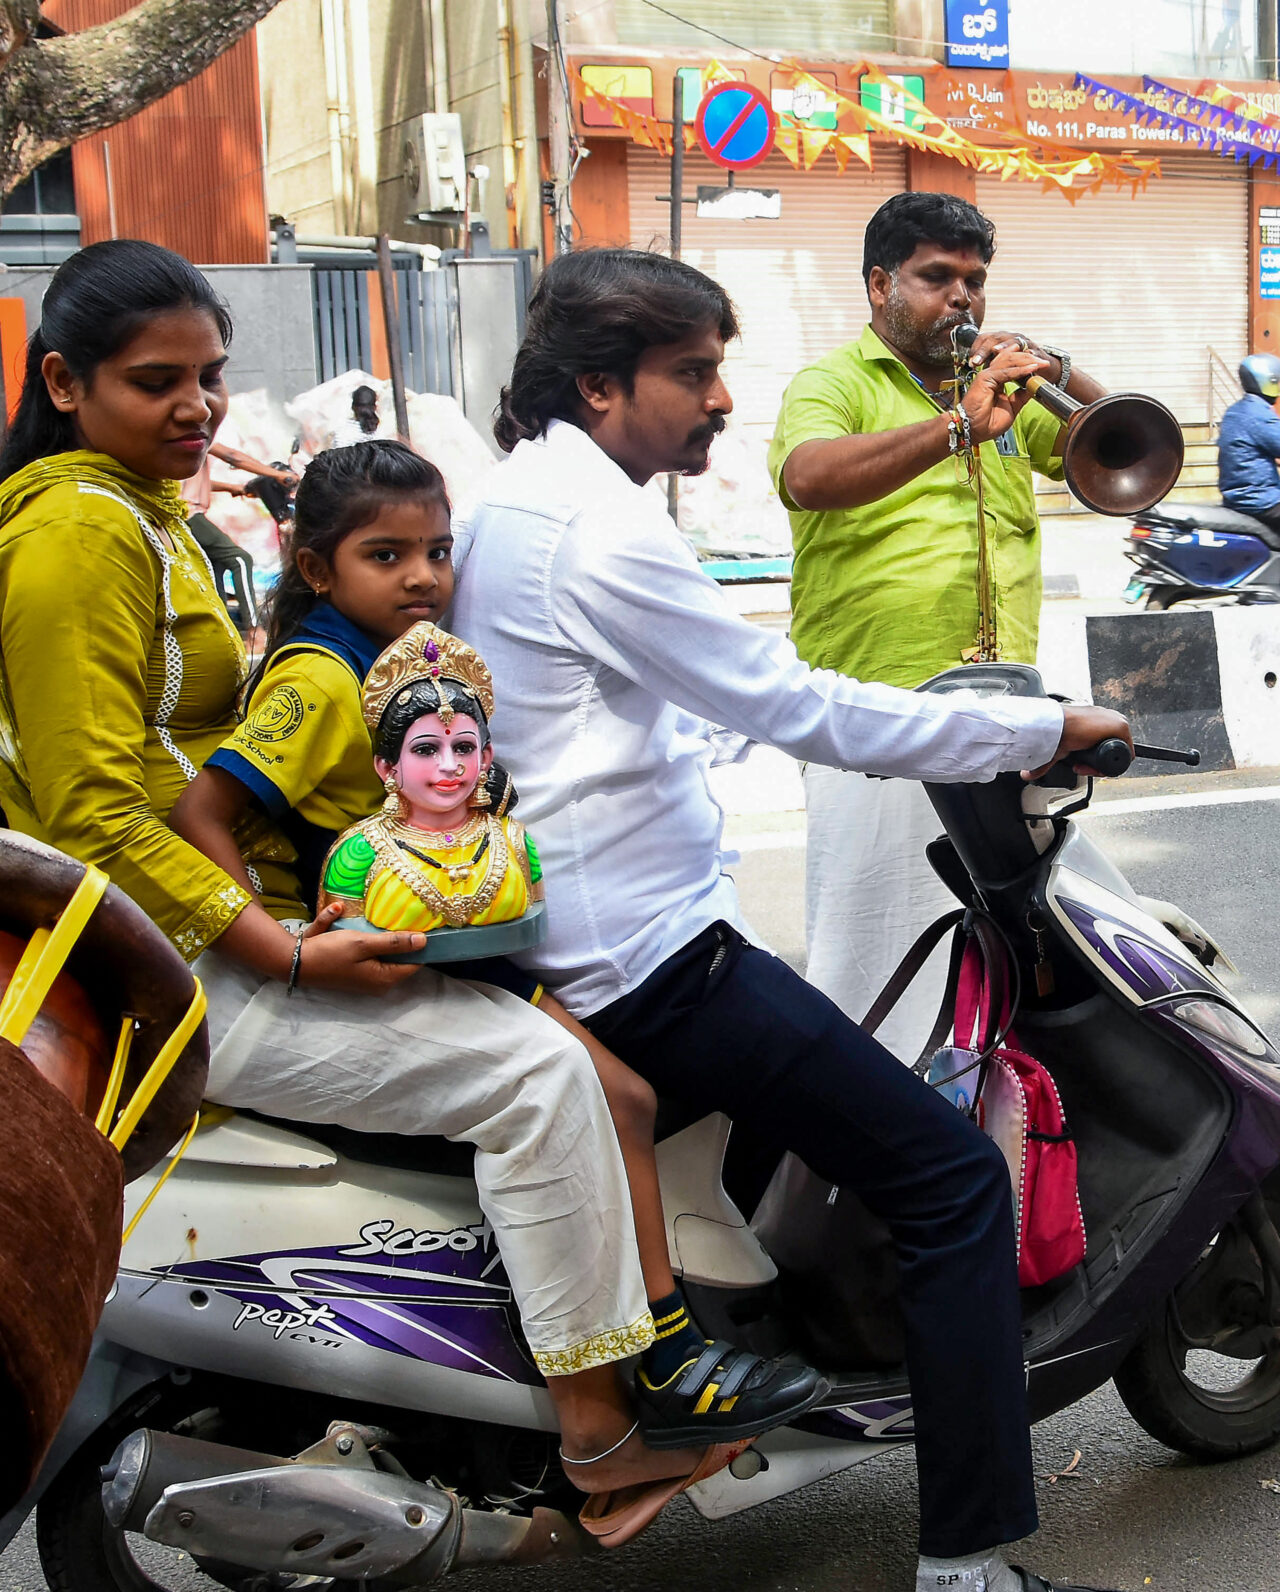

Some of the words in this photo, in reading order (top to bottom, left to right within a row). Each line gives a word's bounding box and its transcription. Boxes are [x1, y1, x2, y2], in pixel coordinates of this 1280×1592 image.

[1027, 120, 1051, 137] No.
[1056, 122, 1083, 140] 111,
[1087, 123, 1126, 139] Paras
[1130, 123, 1184, 142] Towers,
